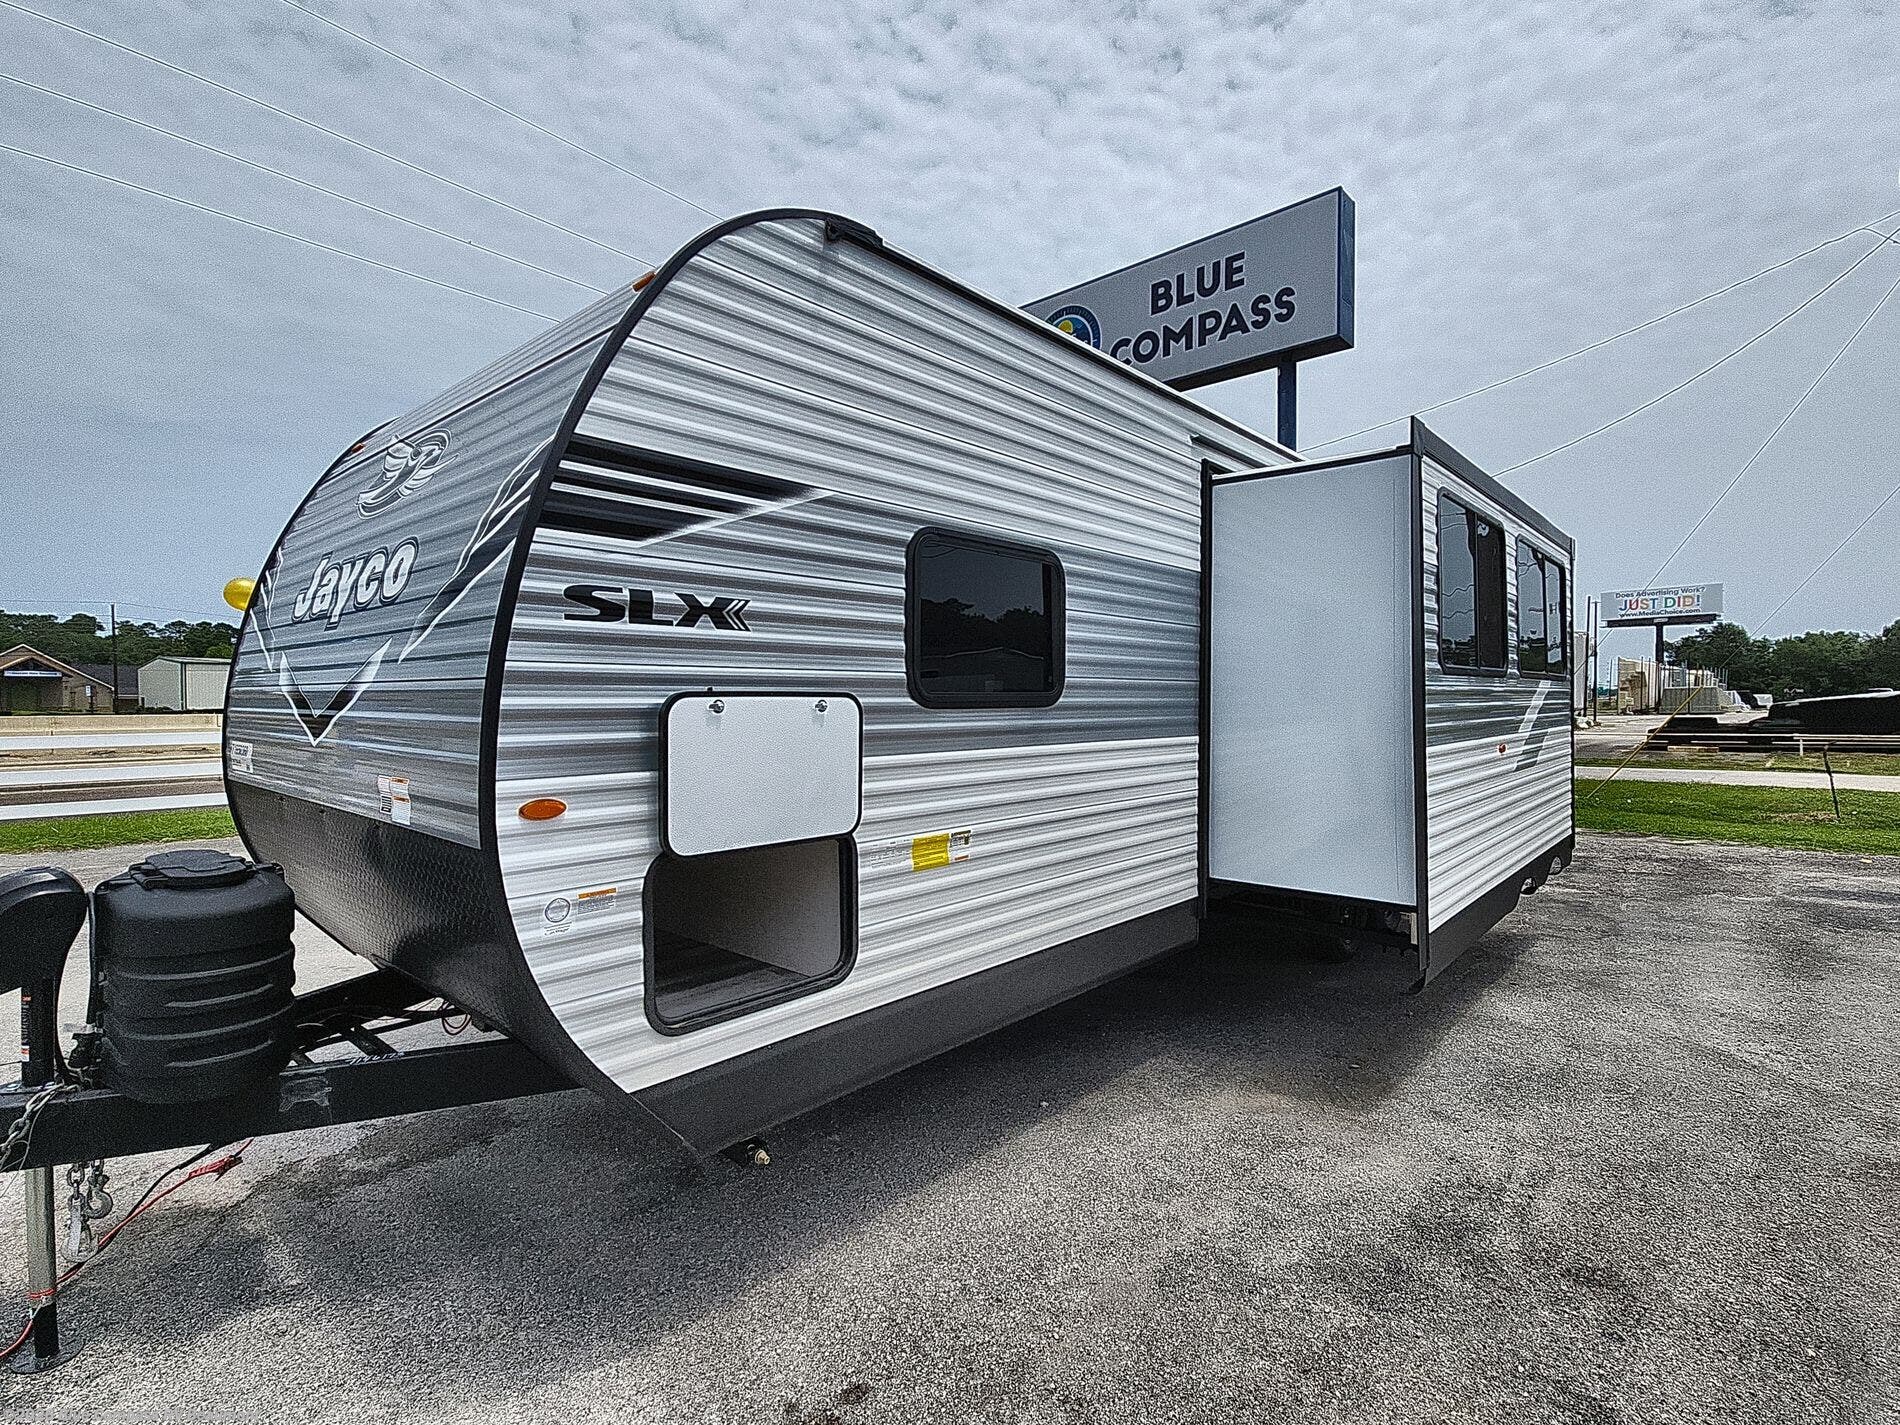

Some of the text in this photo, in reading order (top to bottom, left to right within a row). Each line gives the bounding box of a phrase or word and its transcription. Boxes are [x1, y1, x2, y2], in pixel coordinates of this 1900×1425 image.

[1150, 251, 1247, 316] BLUE
[1109, 286, 1297, 367] COMPASS
[291, 536, 420, 631] Jayco
[1619, 595, 1701, 611] JUST DID!
[1635, 589, 1679, 598] Advertising
[1680, 586, 1706, 594] Work?
[563, 584, 751, 632] SLX
[1619, 608, 1701, 618] www.MediaChoice.com
